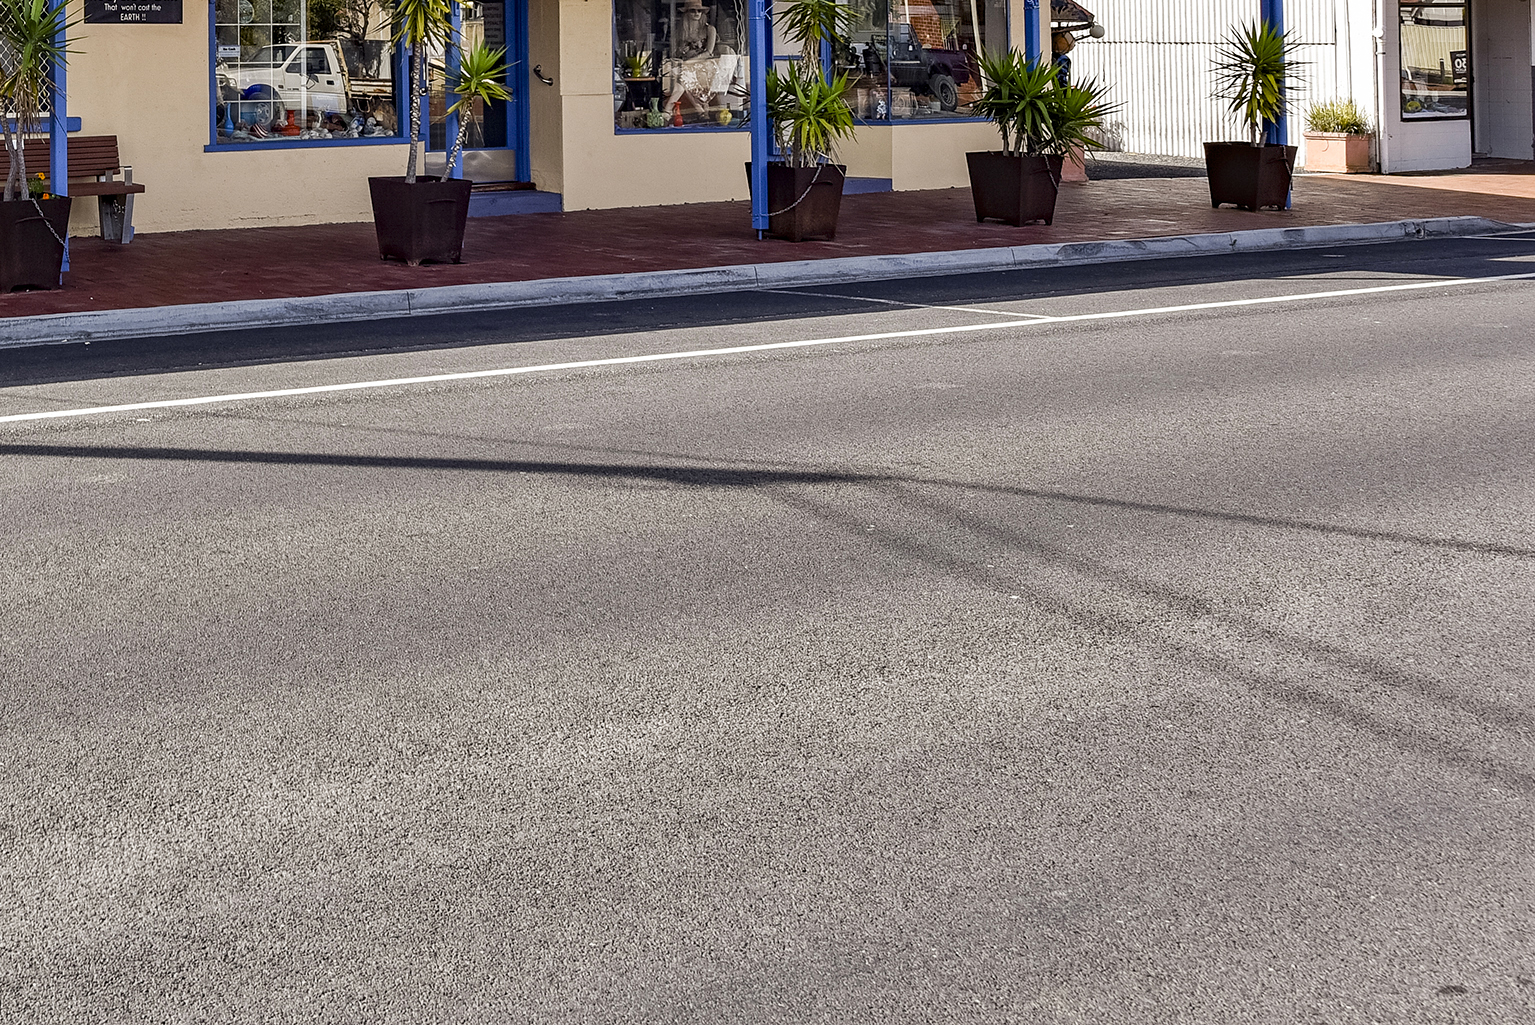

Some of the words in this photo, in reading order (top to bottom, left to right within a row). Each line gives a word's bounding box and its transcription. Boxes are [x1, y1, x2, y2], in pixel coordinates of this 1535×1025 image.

[104, 3, 118, 11] That
[121, 3, 137, 11] won't
[138, 3, 150, 11] cost
[151, 3, 162, 11] the
[120, 13, 140, 21] EARTH
